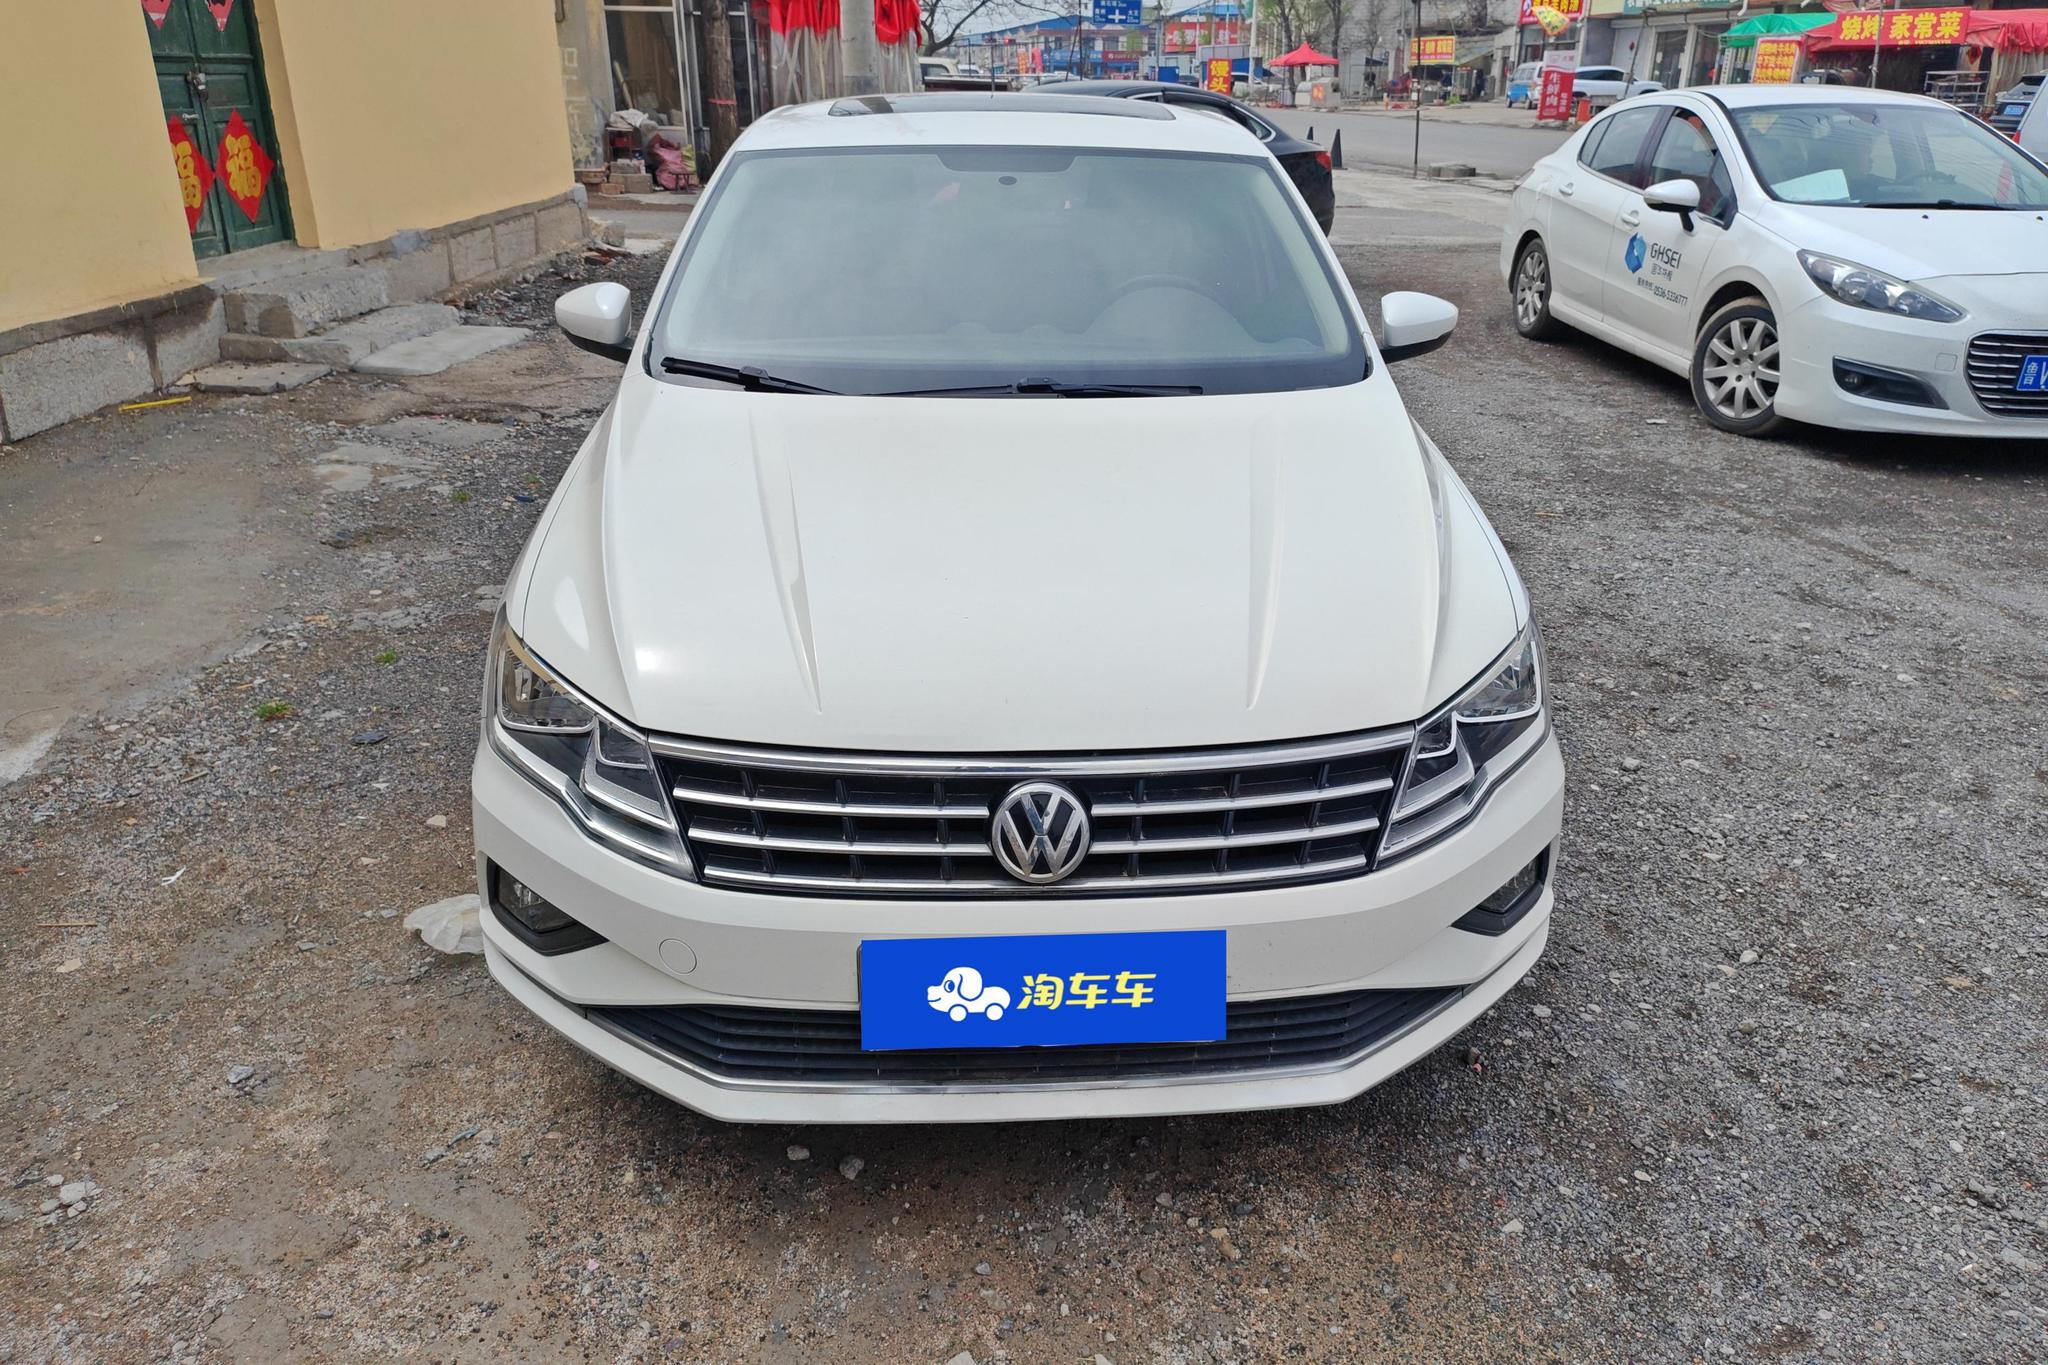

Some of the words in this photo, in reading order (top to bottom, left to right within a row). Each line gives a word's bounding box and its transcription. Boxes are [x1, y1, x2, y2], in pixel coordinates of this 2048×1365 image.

[1888, 11, 1963, 39] 家常菜
[1209, 60, 1229, 92] 馒头
[225, 134, 261, 200] 福
[1650, 242, 1682, 270] GHSEI
